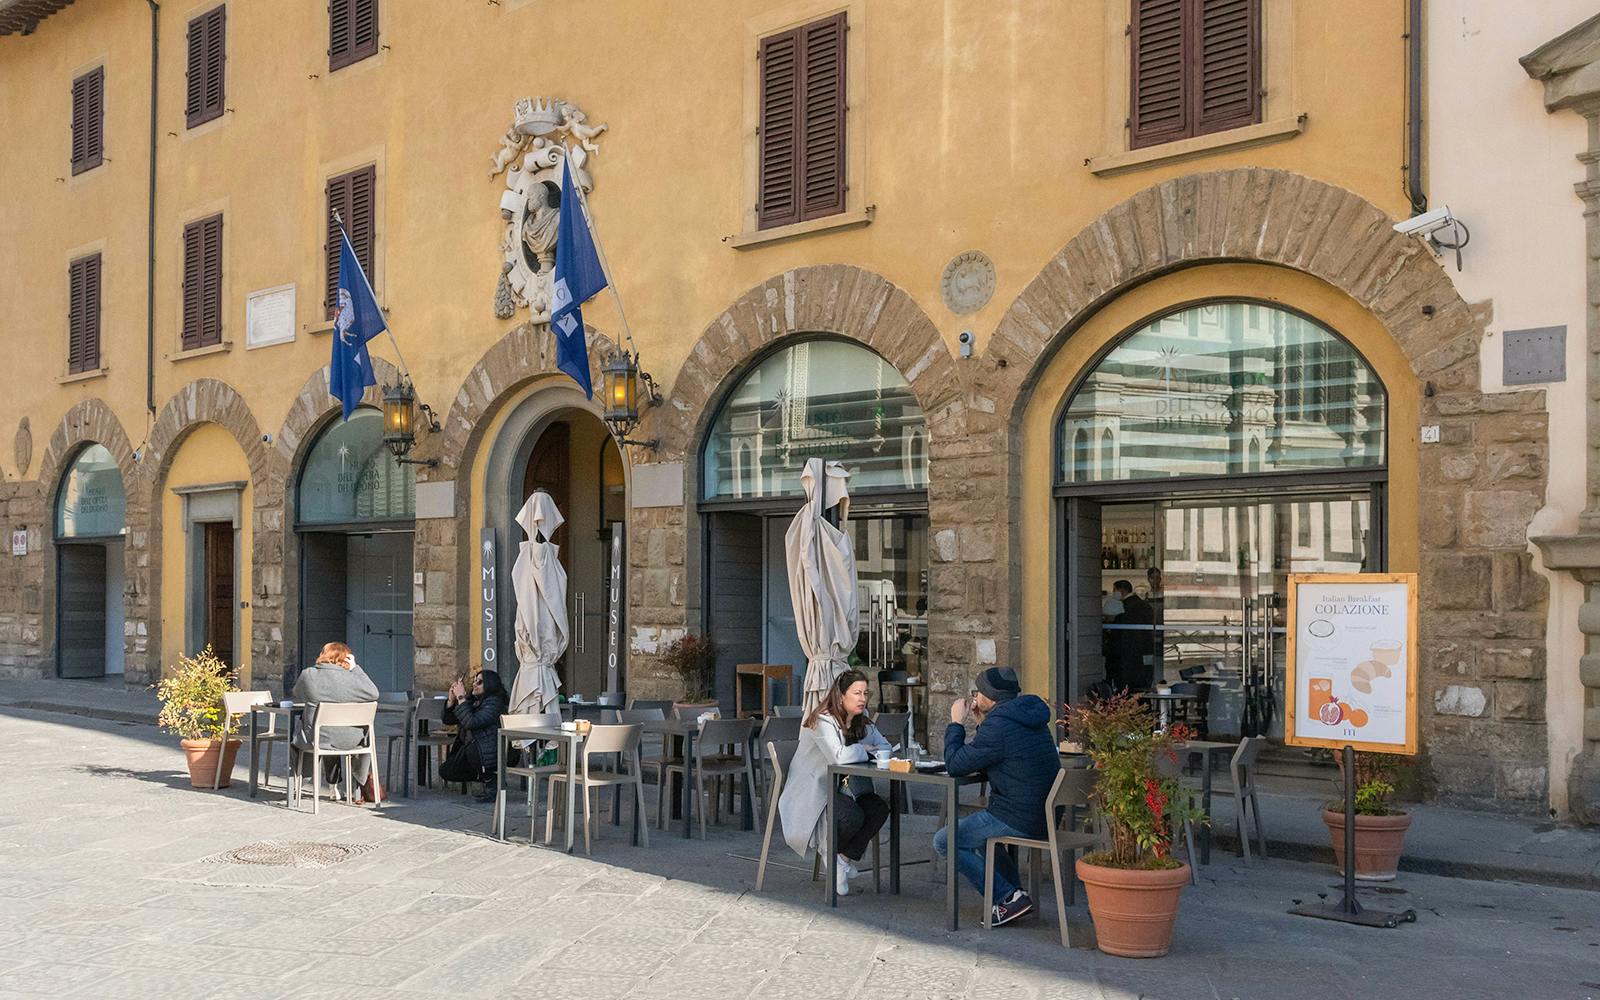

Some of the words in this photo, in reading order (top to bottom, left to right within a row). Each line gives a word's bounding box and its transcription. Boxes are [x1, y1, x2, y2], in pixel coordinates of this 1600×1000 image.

[351, 480, 380, 492] DOMO
[1322, 594, 1346, 603] Italian
[1347, 594, 1381, 603] Breakfast
[482, 566, 495, 662] MUSEO
[1315, 604, 1390, 615] COLAZIONE
[608, 565, 621, 668] MUSEO
